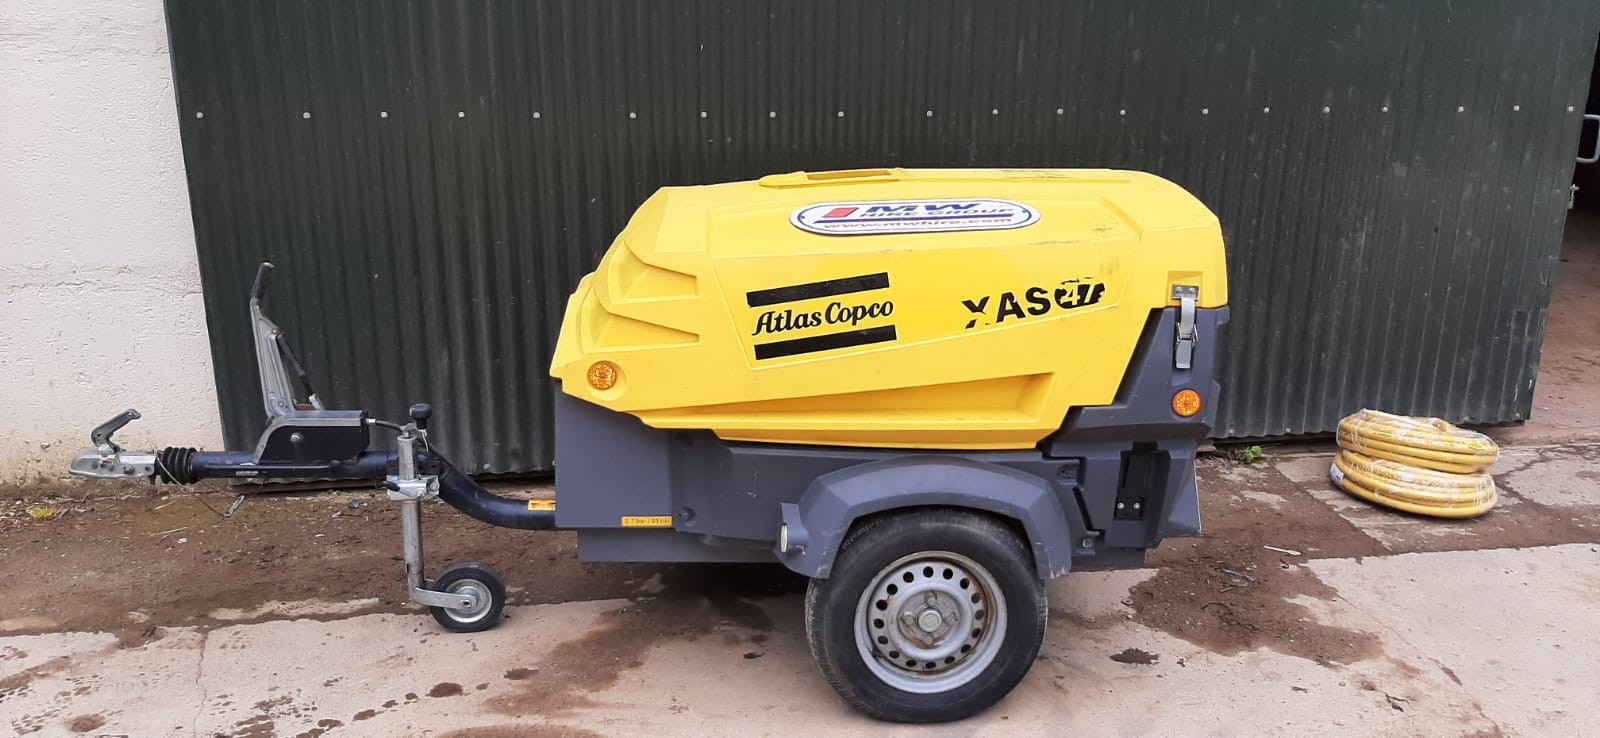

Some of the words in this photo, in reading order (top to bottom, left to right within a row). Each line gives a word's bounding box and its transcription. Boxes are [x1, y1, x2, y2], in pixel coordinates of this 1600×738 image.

[866, 203, 980, 213] MW
[927, 208, 1014, 216] GROUP
[824, 218, 1012, 229] www.mwhire.com
[961, 286, 1051, 329] XAS
[751, 309, 822, 336] Atlas
[824, 300, 894, 327] Copco
